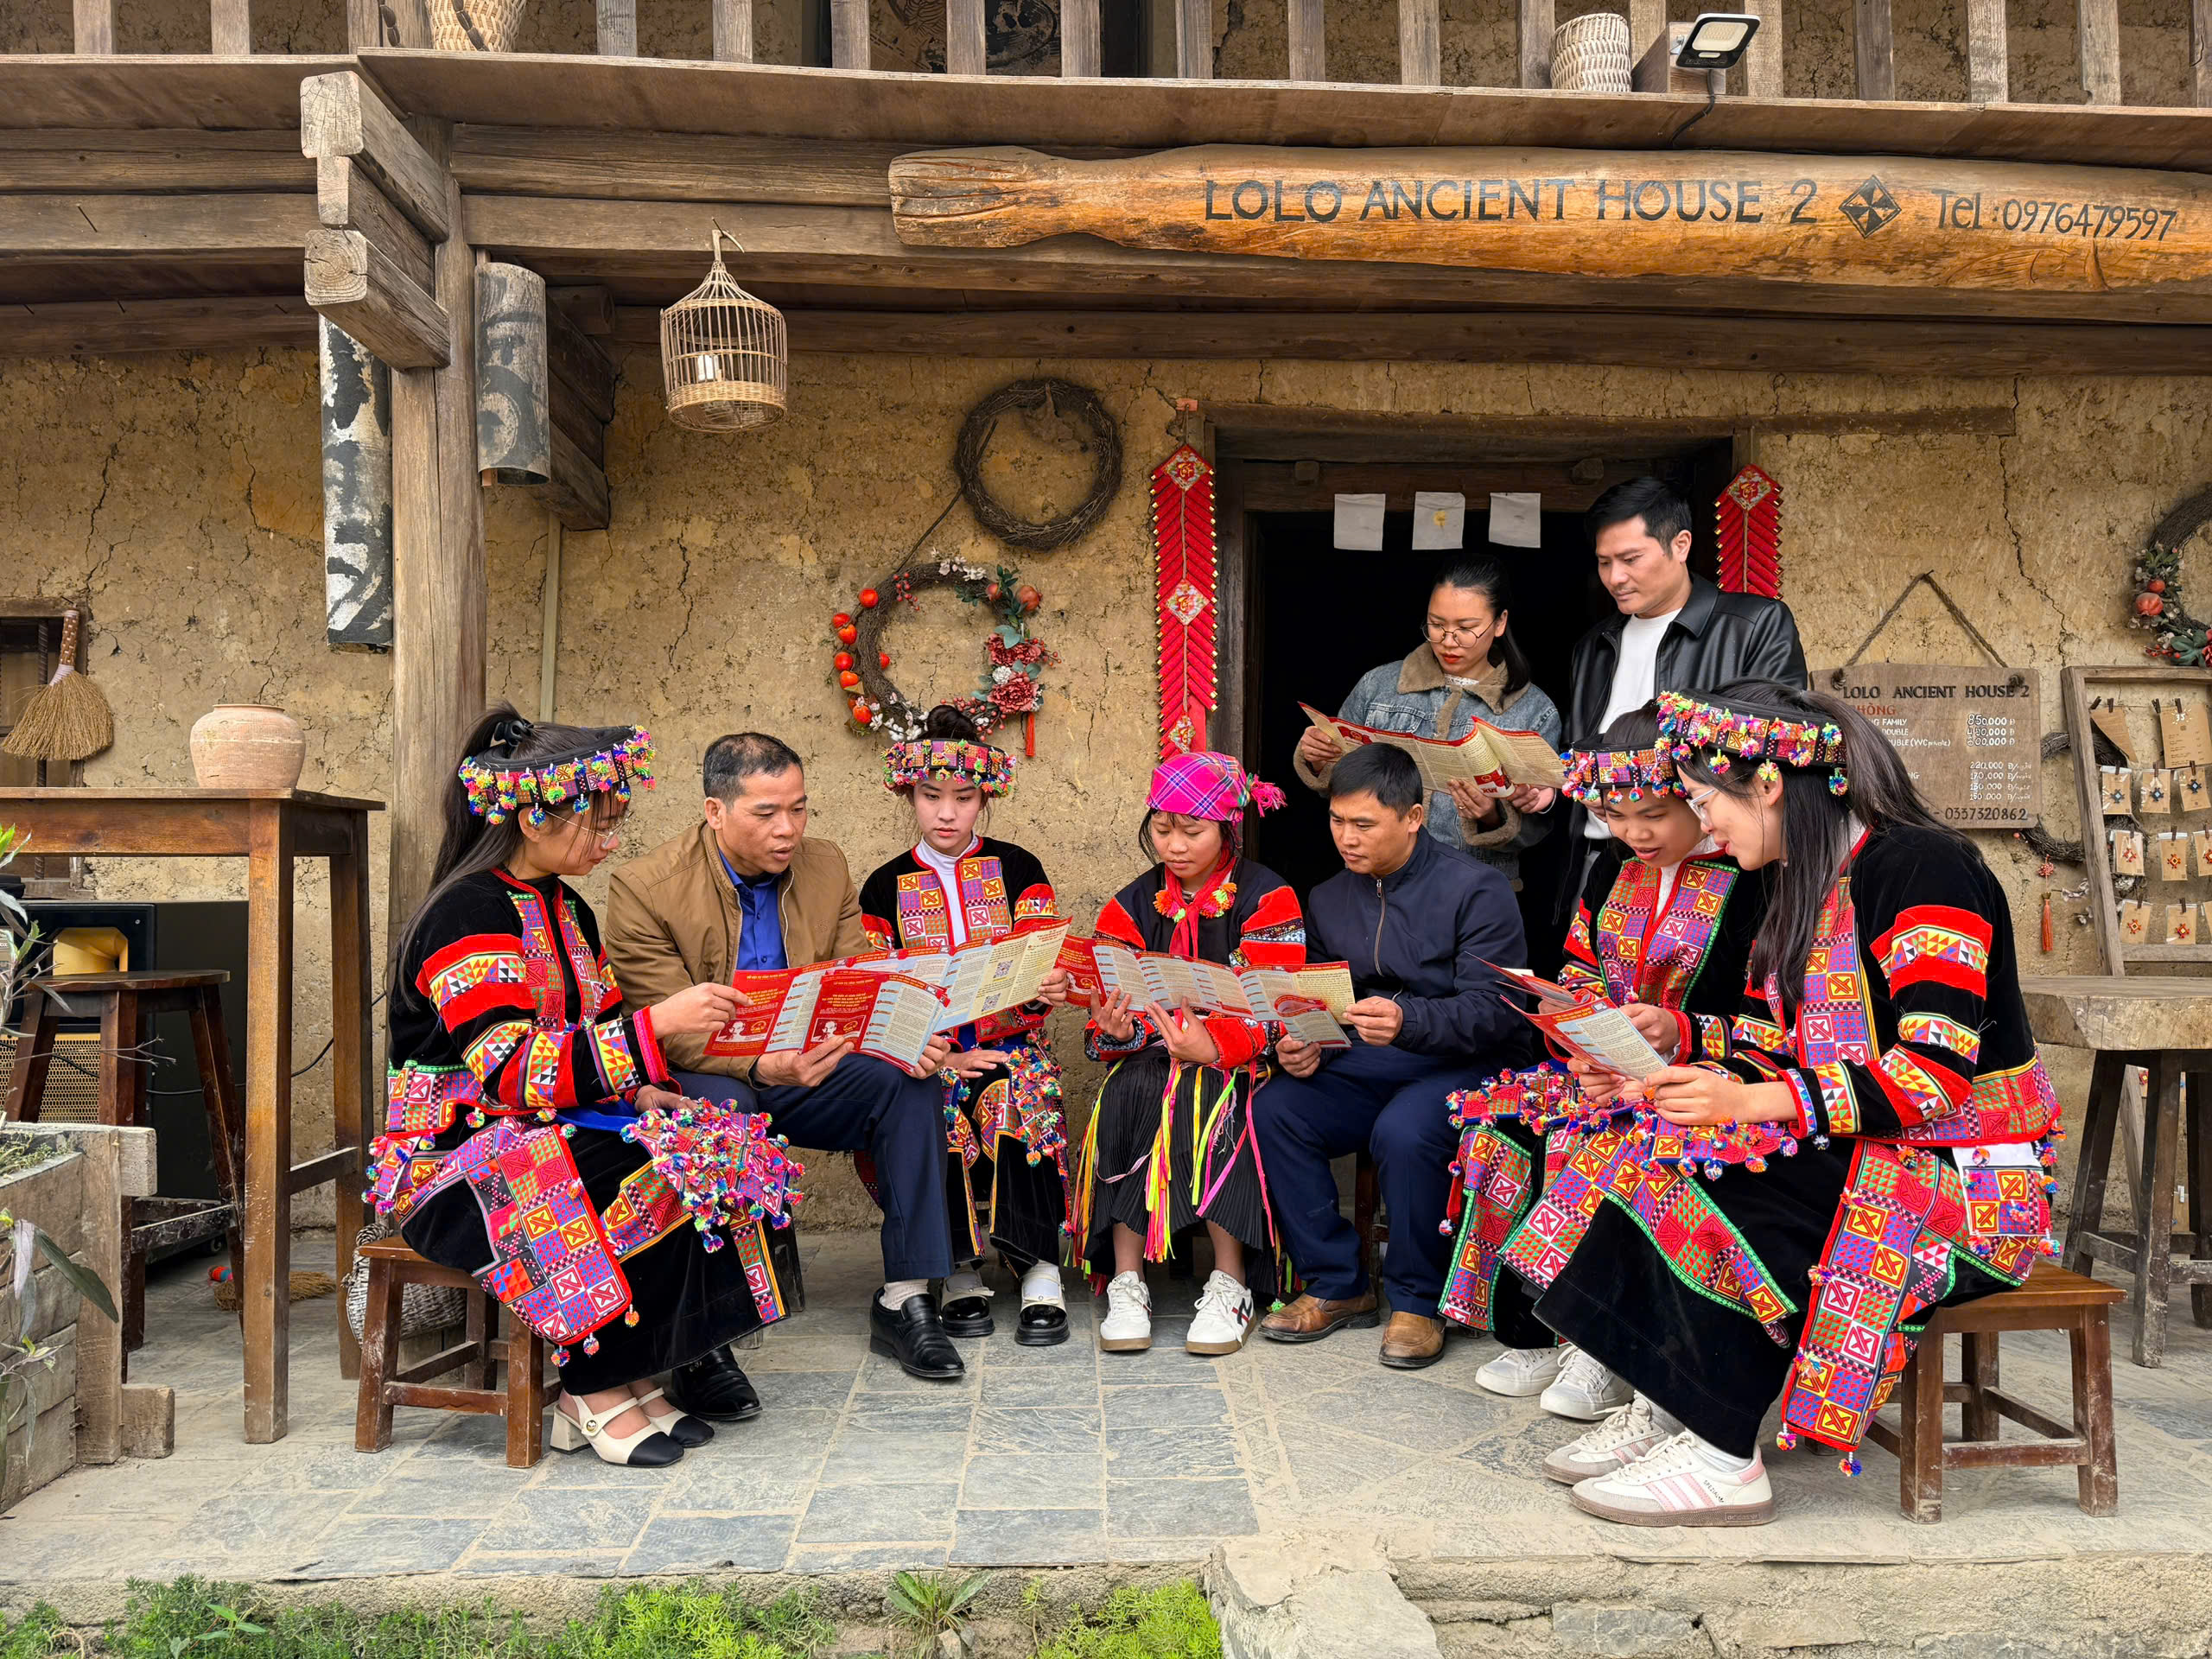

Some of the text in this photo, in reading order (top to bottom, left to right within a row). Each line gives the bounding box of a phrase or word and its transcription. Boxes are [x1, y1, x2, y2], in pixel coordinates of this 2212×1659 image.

[1205, 178, 1818, 224] LOLO ANCIENT HOUSE 2
[1843, 684, 2030, 699] LOLO ANCIENT HOUSE 2
[1857, 702, 1897, 716] HÒNG
